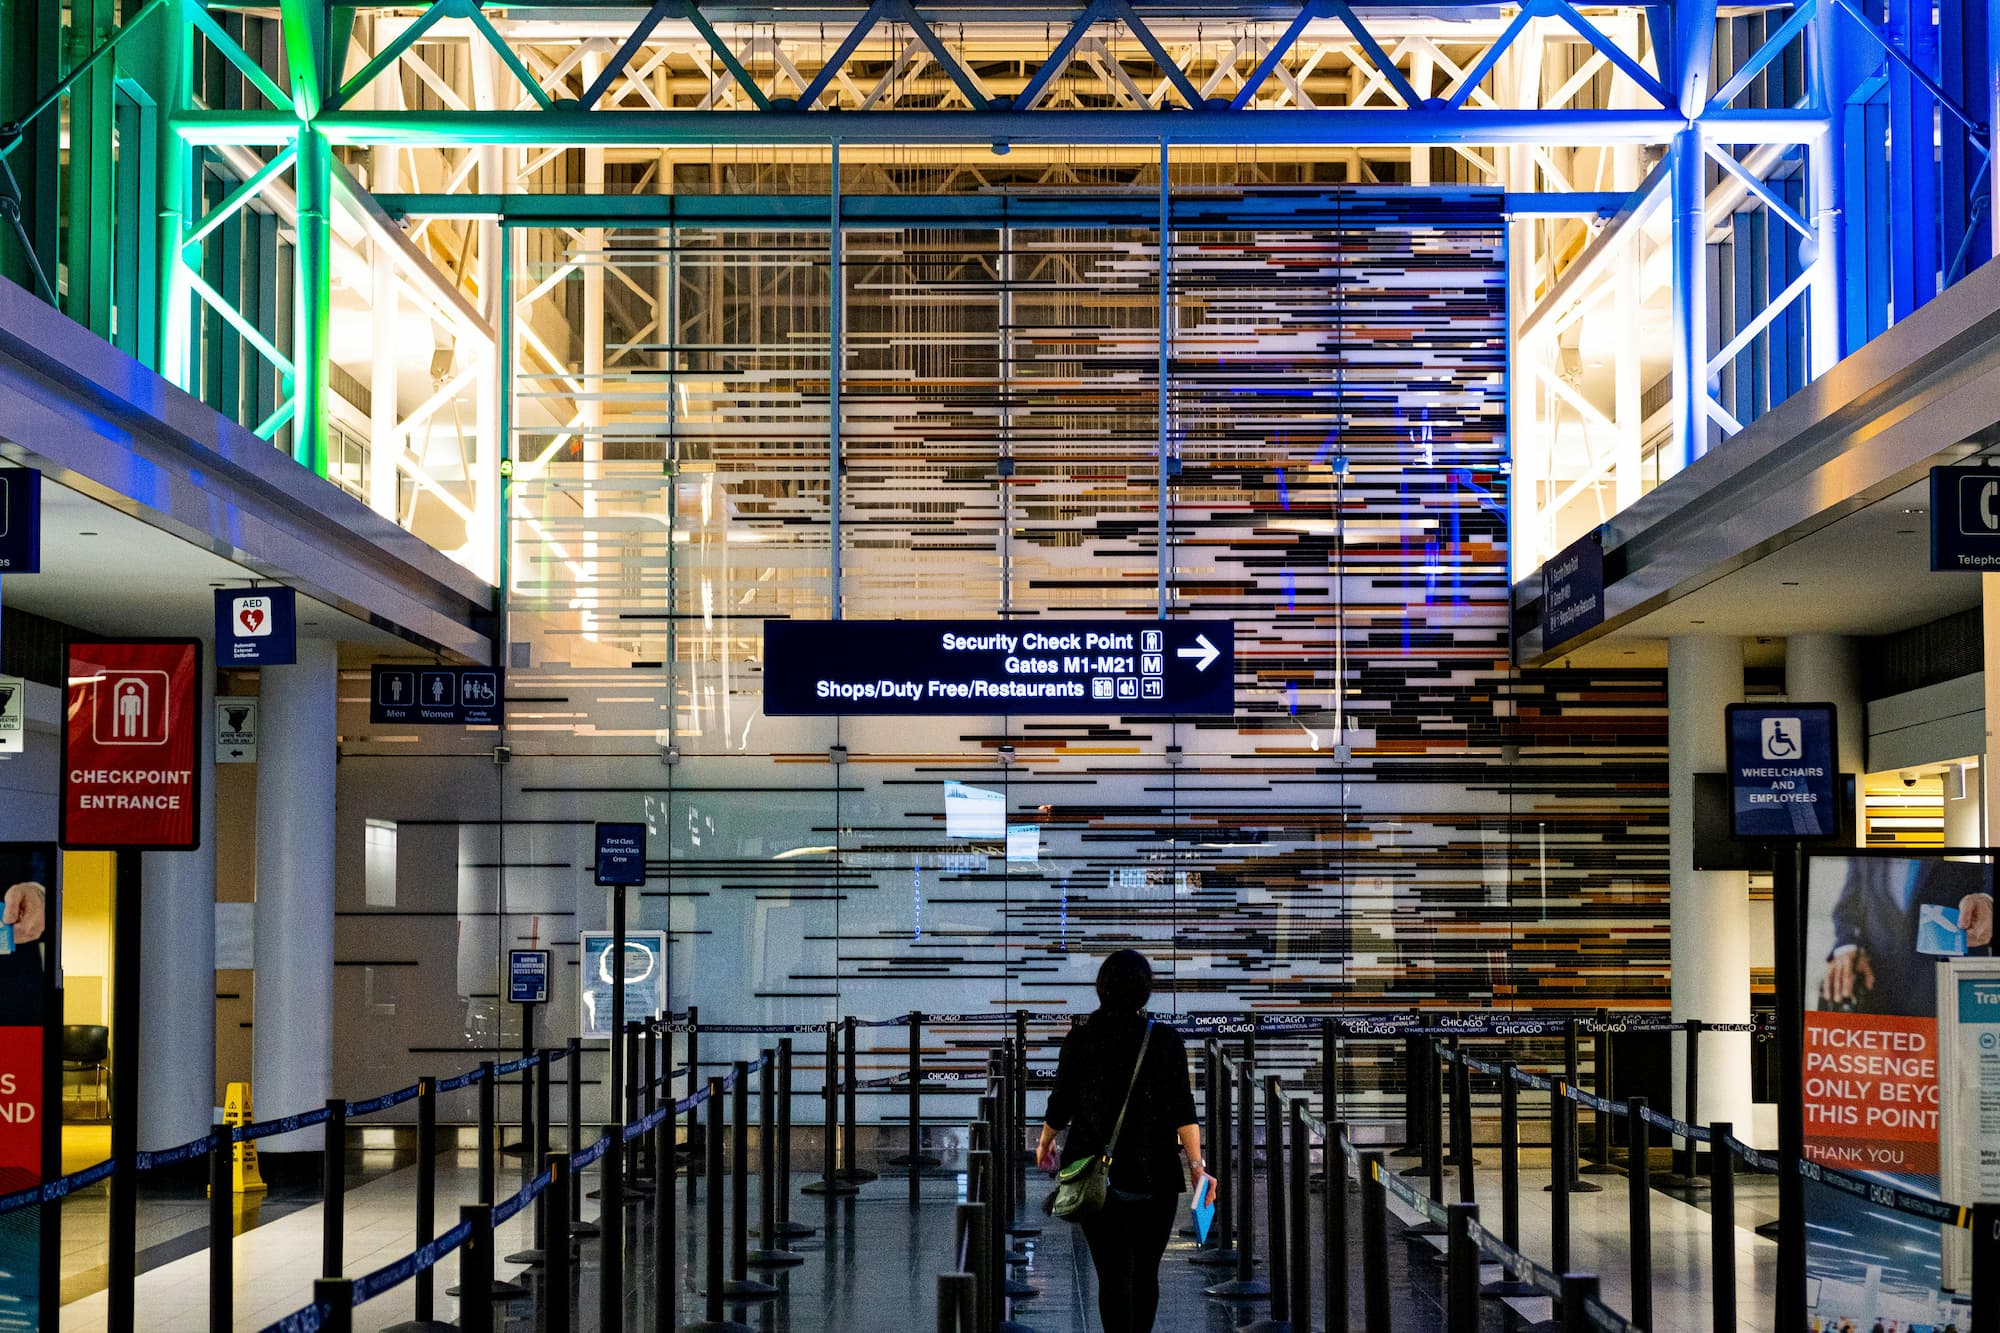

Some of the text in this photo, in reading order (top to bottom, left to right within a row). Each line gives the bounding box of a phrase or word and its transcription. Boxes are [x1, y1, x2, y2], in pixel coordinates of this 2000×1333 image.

[242, 599, 263, 608] AED
[942, 633, 1134, 652] Security Check Point
[1004, 656, 1160, 673] Gates M1-M21 M
[816, 681, 1084, 700] Shops/Duty Free/Restaurants
[386, 709, 406, 718] Men
[421, 710, 454, 718] Women
[70, 769, 192, 785] CHECKPOINT
[1742, 767, 1824, 777] WHEELCHAIRS
[1770, 781, 1796, 790] AND
[80, 795, 180, 810] ENTRANCE
[1749, 793, 1818, 803] EMPLOYEES
[1195, 1016, 1228, 1026] CHICAGO
[1264, 1015, 1305, 1023] CHICAGO
[1441, 1019, 1483, 1027] CHICAGO
[651, 1024, 697, 1033] CHICAGO
[1217, 1024, 1255, 1033] CHICAGO
[1350, 1025, 1397, 1034] CHICAGO
[1495, 1024, 1543, 1034] CHICAGO
[1586, 1024, 1627, 1033] CHICAGO
[1711, 1023, 1757, 1032] CHICAGO
[1807, 1027, 1926, 1052] TICKETED
[927, 1072, 960, 1081] CHICAGO
[1805, 1078, 1872, 1100] ONLY
[1804, 1103, 1939, 1129] THIS POINT
[1803, 1144, 1904, 1164] THANK YOU
